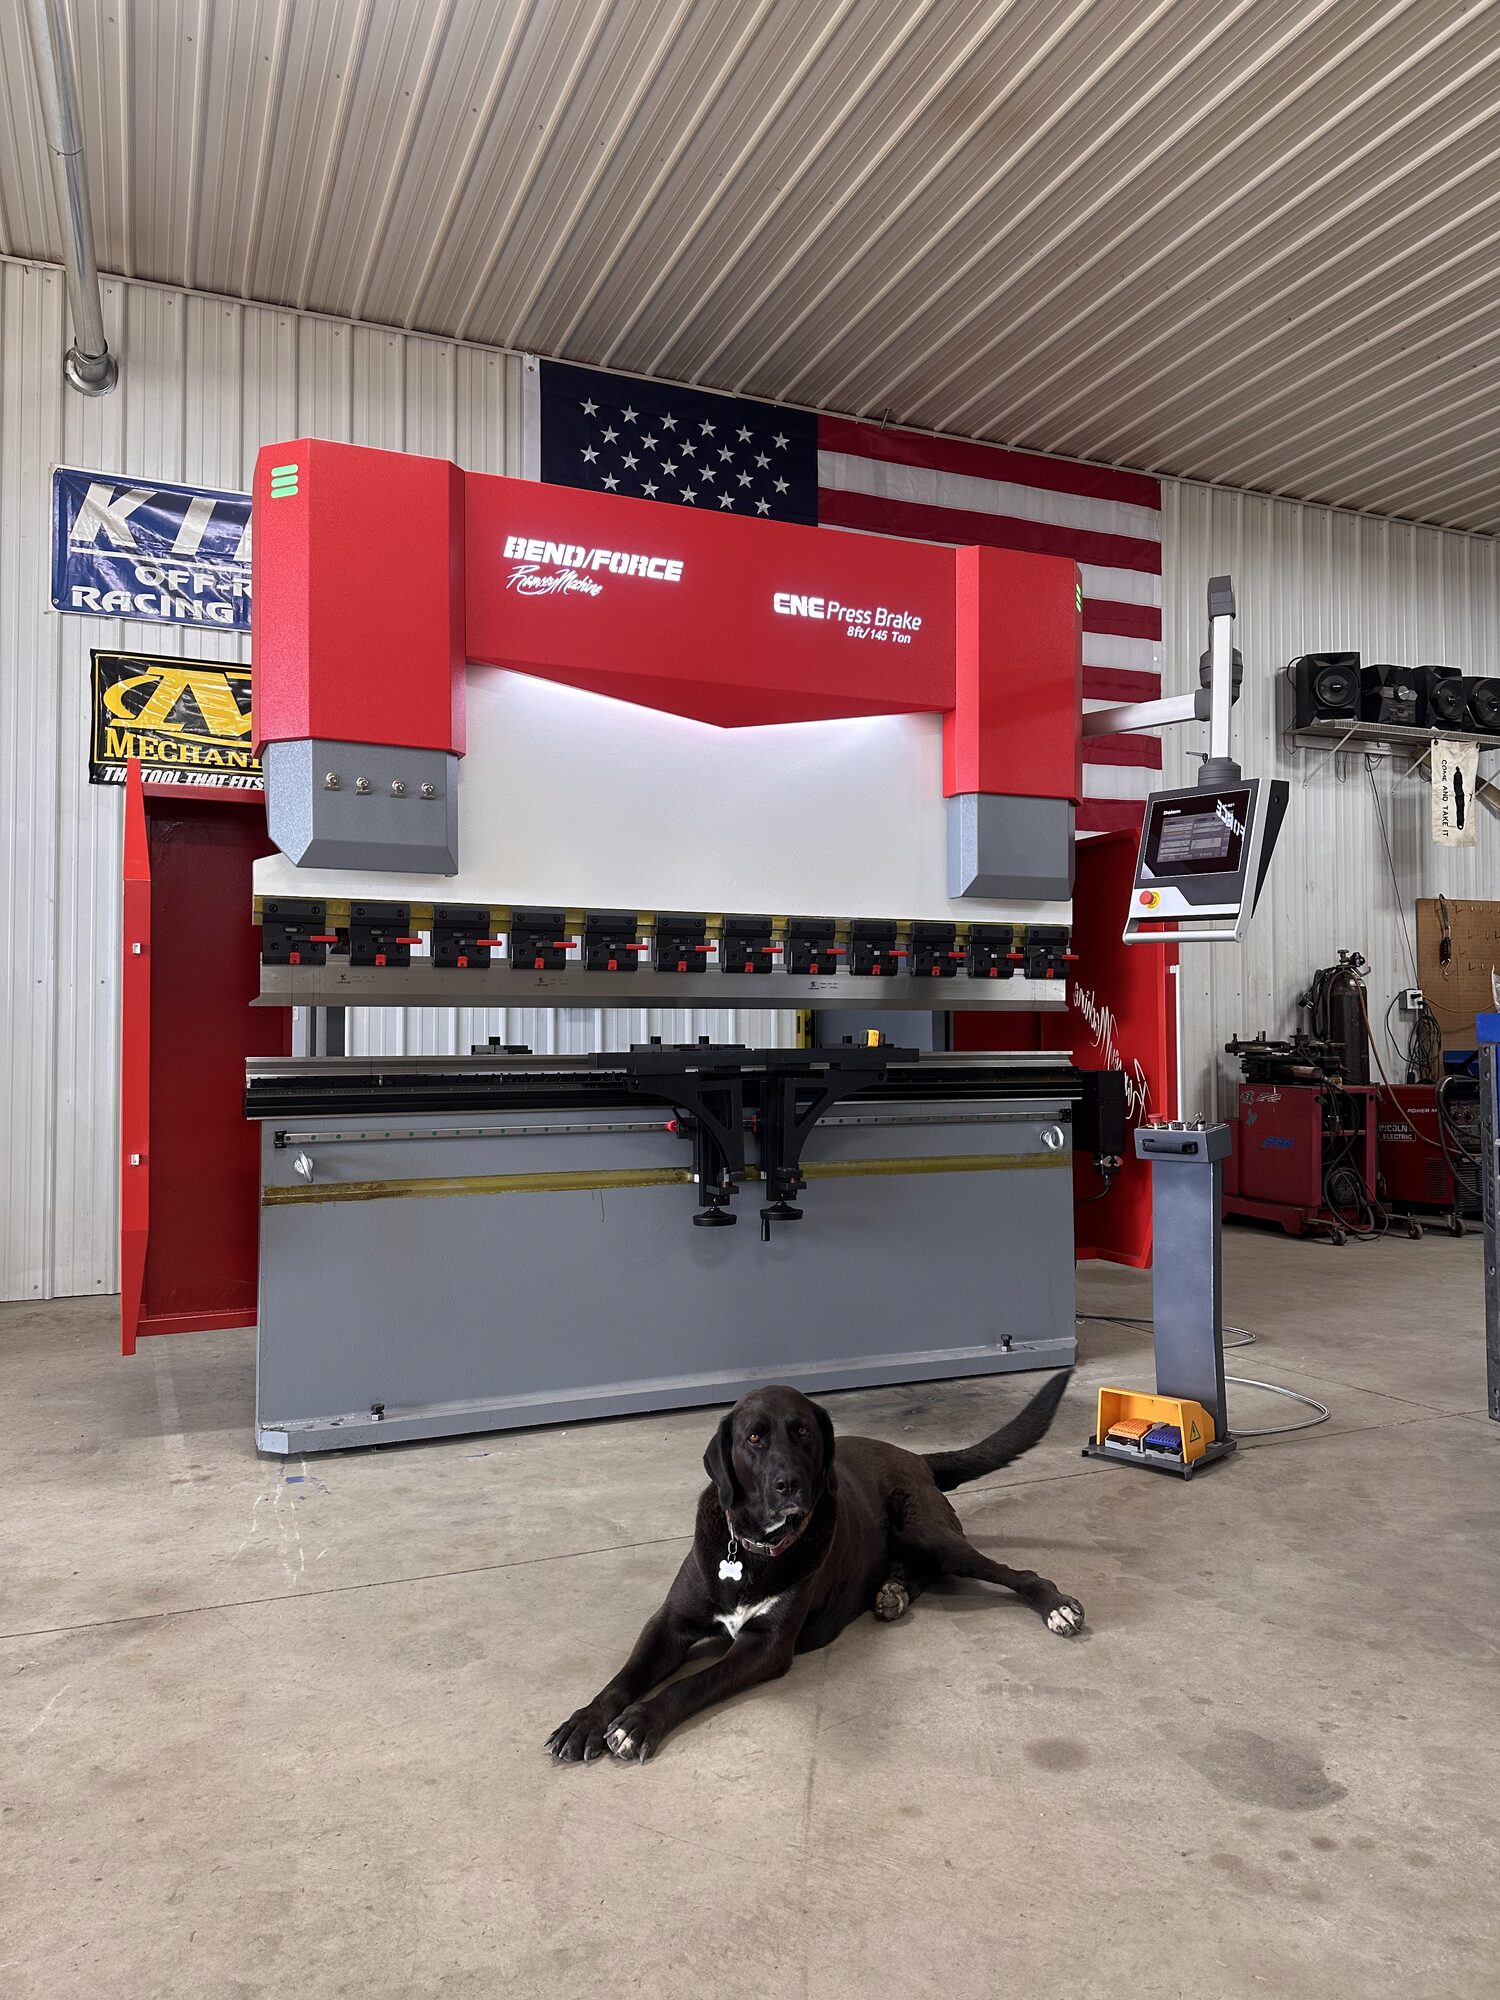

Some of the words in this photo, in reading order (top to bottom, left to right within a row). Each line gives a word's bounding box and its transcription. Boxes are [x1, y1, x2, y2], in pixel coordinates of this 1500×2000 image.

[69, 482, 252, 562] KI
[502, 535, 685, 582] BEND/FORCE
[551, 568, 604, 597] Machine
[70, 585, 234, 624] RACING
[826, 601, 872, 625] Press
[874, 607, 922, 631] Brake
[891, 631, 911, 644] Ton
[103, 766, 128, 783] TH
[140, 768, 182, 785] TOOL
[185, 772, 229, 787] THAT
[228, 775, 265, 791] FITS
[1441, 829, 1449, 837] IT
